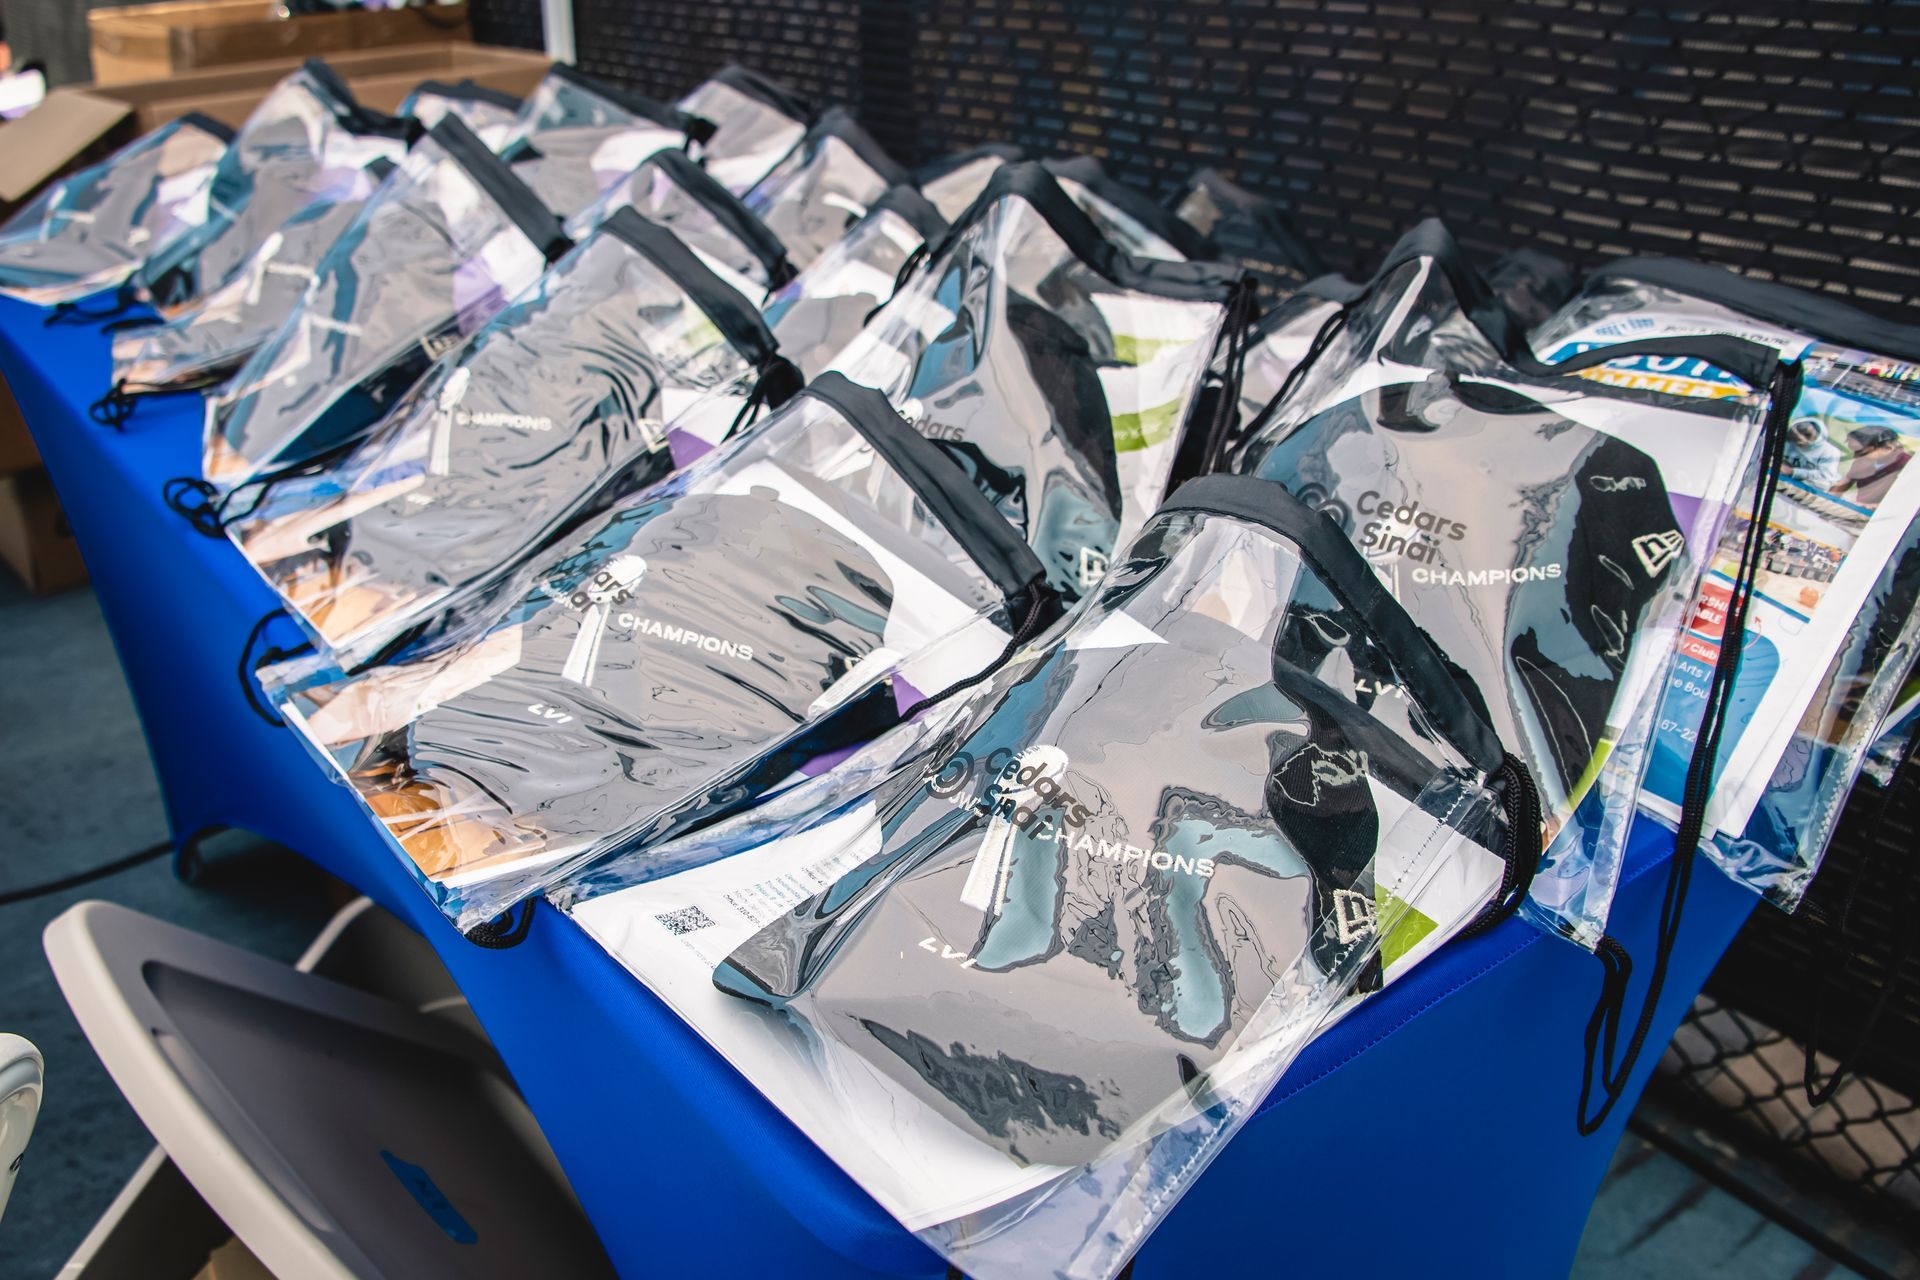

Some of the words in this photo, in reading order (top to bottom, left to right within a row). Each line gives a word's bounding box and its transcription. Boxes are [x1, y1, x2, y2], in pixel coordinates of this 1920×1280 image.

[1357, 490, 1467, 541] Cedars
[1358, 522, 1440, 565] Sinai
[1411, 563, 1562, 587] CHAMPIONS
[618, 612, 754, 661] CHAMPIONS
[1690, 642, 1717, 660] Club
[1678, 661, 1704, 679] Arts
[1684, 681, 1710, 699] Bou
[1661, 718, 1698, 742] 67-22
[984, 747, 1095, 828] Cedars
[984, 783, 1053, 841] Sinai
[1037, 821, 1216, 879] CHAMPIONS
